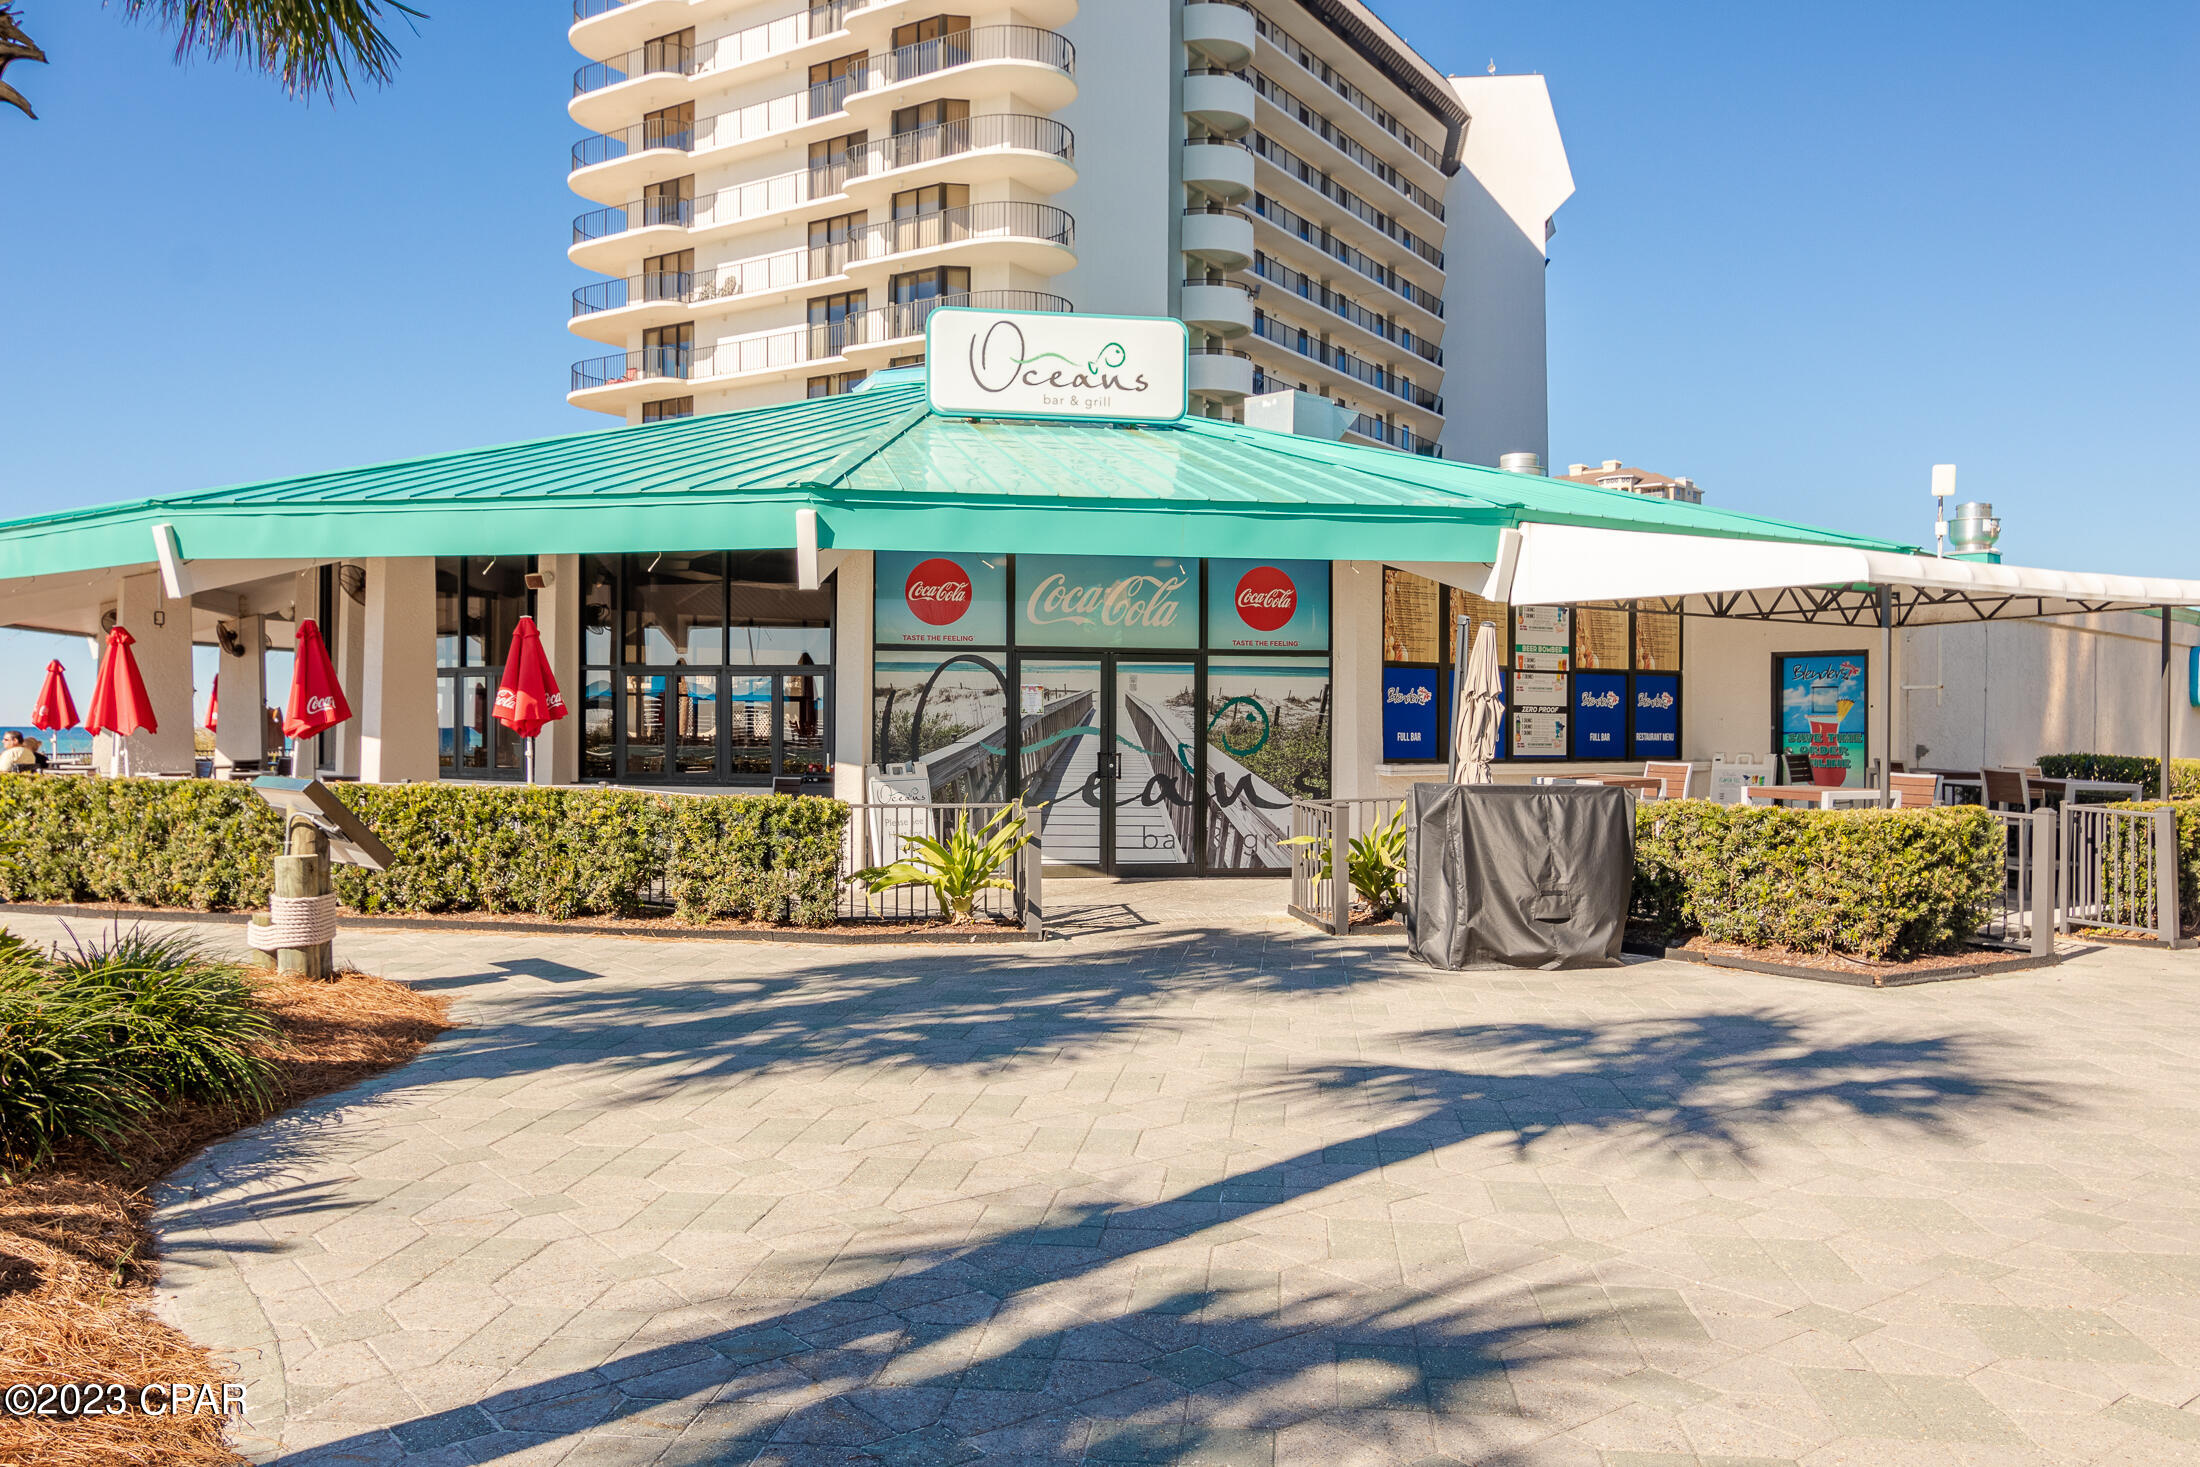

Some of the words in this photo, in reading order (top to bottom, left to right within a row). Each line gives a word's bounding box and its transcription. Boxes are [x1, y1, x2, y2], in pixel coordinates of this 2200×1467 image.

[969, 320, 1149, 392] Oceans
[1043, 394, 1064, 405] bar
[1070, 395, 1079, 406] &
[1085, 396, 1111, 409] grill
[908, 580, 969, 602] Coca-Cola
[1237, 588, 1295, 608] Coca-Cola
[1026, 573, 1189, 627] Coca-Cola
[1792, 663, 1849, 681] Blenders
[880, 653, 1323, 811] Oeans
[1397, 732, 1410, 741] FULL
[1410, 732, 1421, 742] BAR
[1590, 732, 1600, 741] FULL
[1601, 732, 1610, 741] BAR
[1636, 732, 1661, 741] RESTAURANT
[1662, 732, 1674, 741] MENU
[1788, 733, 1823, 743] SAVE
[1827, 733, 1863, 743] TIME
[1799, 745, 1849, 756] ORDER
[1810, 758, 1851, 768] NLINE
